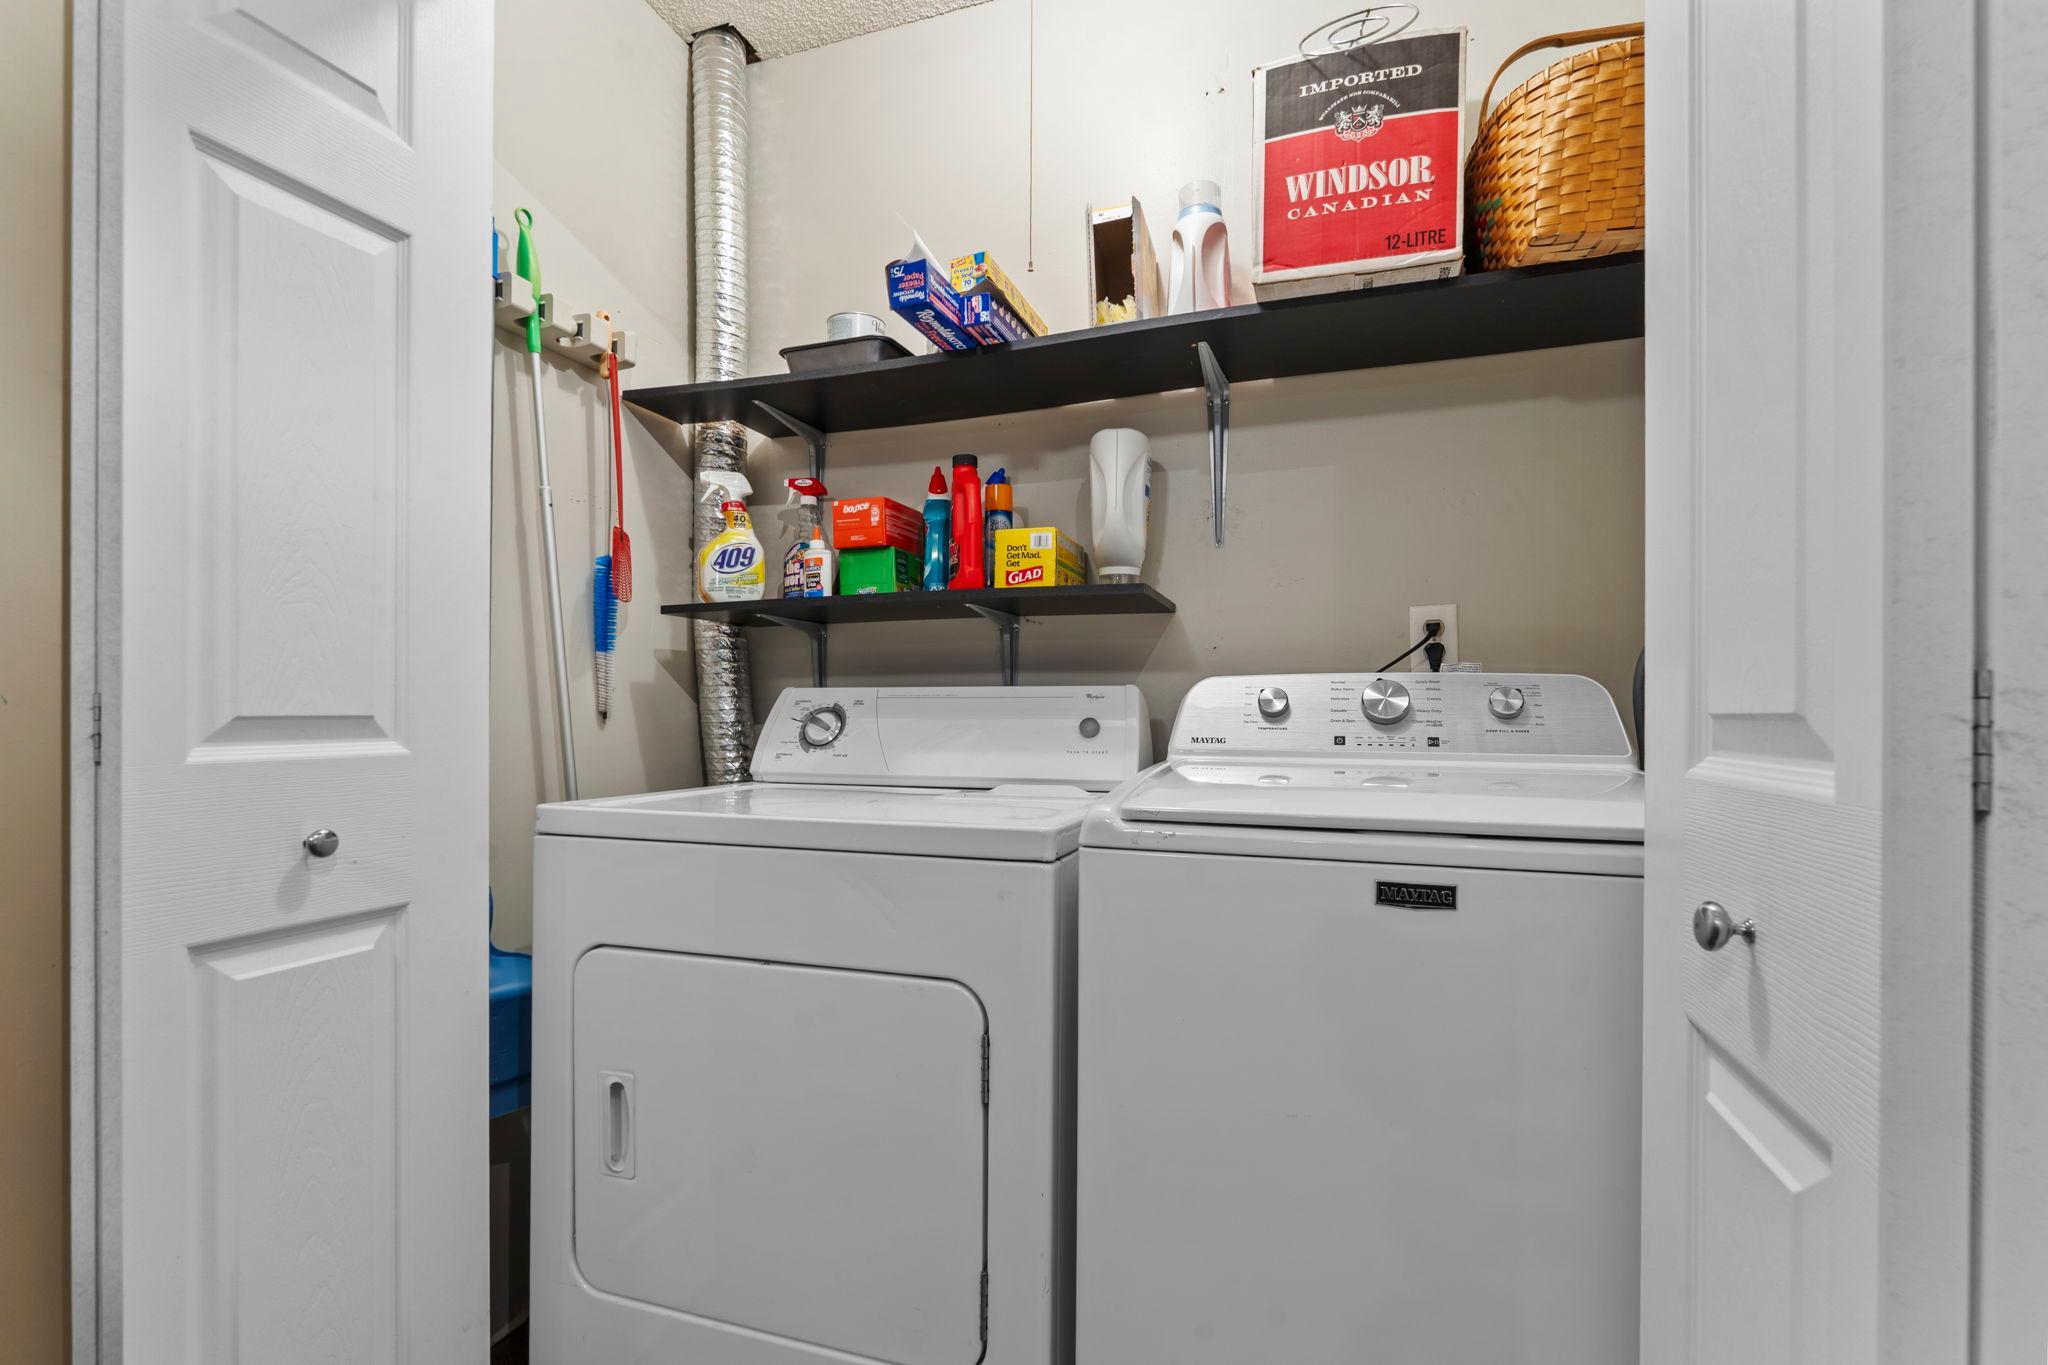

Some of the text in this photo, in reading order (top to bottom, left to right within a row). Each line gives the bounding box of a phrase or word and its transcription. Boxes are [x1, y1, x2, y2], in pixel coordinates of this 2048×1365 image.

[1299, 64, 1423, 97] IMPORTED
[1285, 155, 1435, 203] WINDSOR
[1287, 188, 1433, 220] CANADIAN
[1385, 229, 1447, 250] 12-LITRE
[893, 265, 905, 278] 75
[903, 271, 925, 282] Paper
[898, 279, 925, 289] Freezer
[980, 310, 987, 322] 50
[842, 502, 871, 514] bounce
[733, 514, 746, 523] 40
[1006, 544, 1027, 552] Don't
[713, 546, 756, 570] 409
[1006, 552, 1020, 560] Get
[1008, 568, 1042, 585] GLAD
[1190, 736, 1227, 744] MAYTAG
[1380, 886, 1453, 904] MAYTAG
